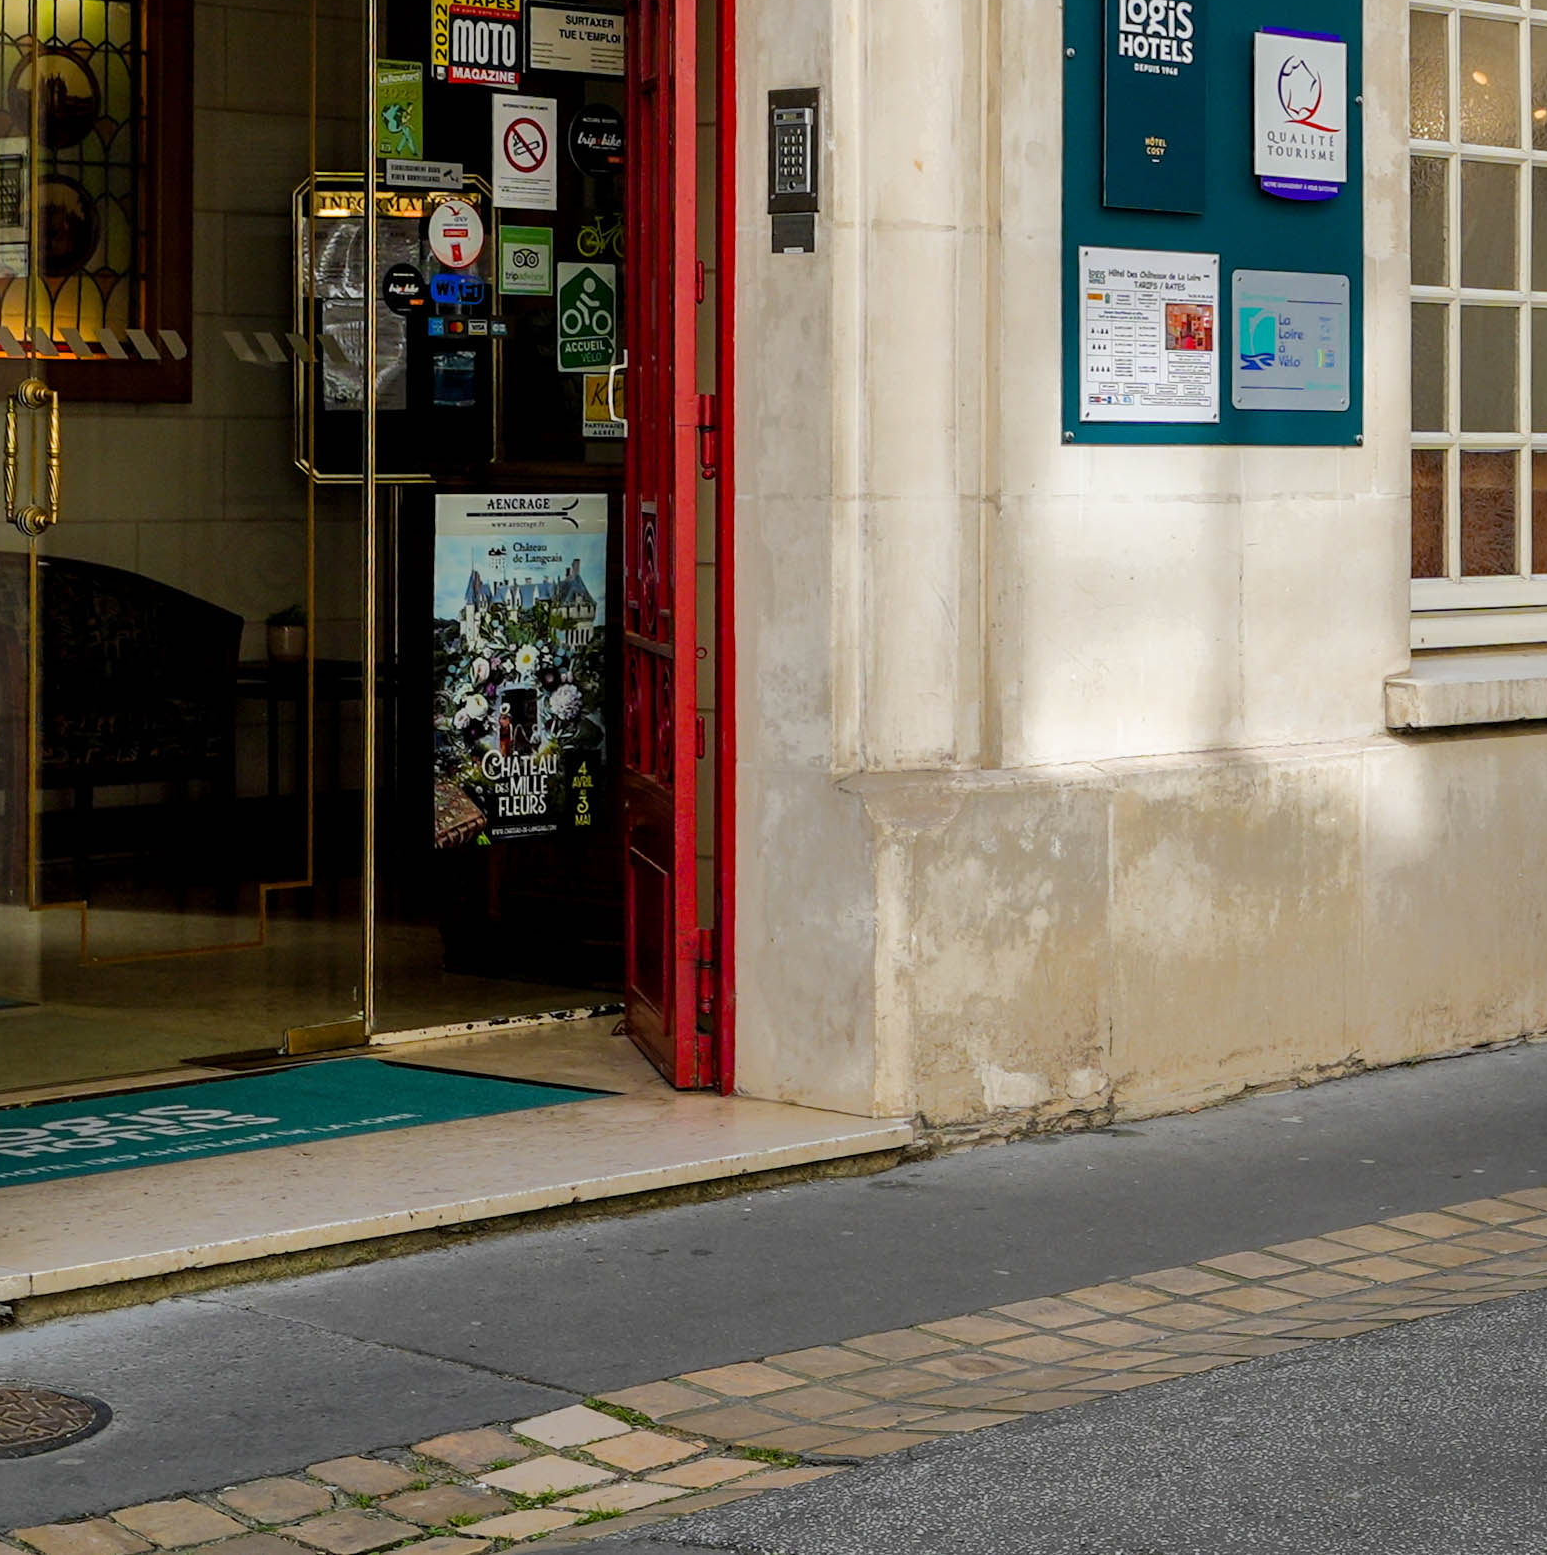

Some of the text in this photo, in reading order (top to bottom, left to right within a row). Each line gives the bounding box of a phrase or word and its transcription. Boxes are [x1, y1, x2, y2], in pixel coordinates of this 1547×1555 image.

[565, 15, 614, 29] SURTAXER
[435, 3, 448, 61] 2022
[559, 29, 621, 44] TUE L'EMPLOI
[453, 19, 516, 67] MOTO
[1119, 33, 1193, 64] HOTELS
[453, 66, 515, 83] MAGAZINE
[1134, 63, 1160, 74] DEPUIS
[1267, 131, 1334, 147] QUALITÉ
[1267, 145, 1334, 161] TOURISME
[1177, 273, 1185, 281] La
[1187, 273, 1201, 281] Loire
[1278, 313, 1291, 326] La
[1278, 328, 1303, 340] Loire
[564, 341, 605, 353] ACCUEIL
[1279, 341, 1285, 353] à
[1279, 355, 1301, 368] Vélo
[487, 498, 550, 510] AENCRAGE
[491, 521, 545, 529] www.aencrage.fr
[513, 542, 547, 552] Château
[513, 553, 562, 565] de Langeais
[578, 761, 586, 775] 4
[495, 775, 548, 796] DES MILLE
[572, 776, 593, 788] AVRIL
[498, 794, 547, 817] FLEURS
[577, 797, 589, 813] 3
[575, 814, 591, 826] MAI
